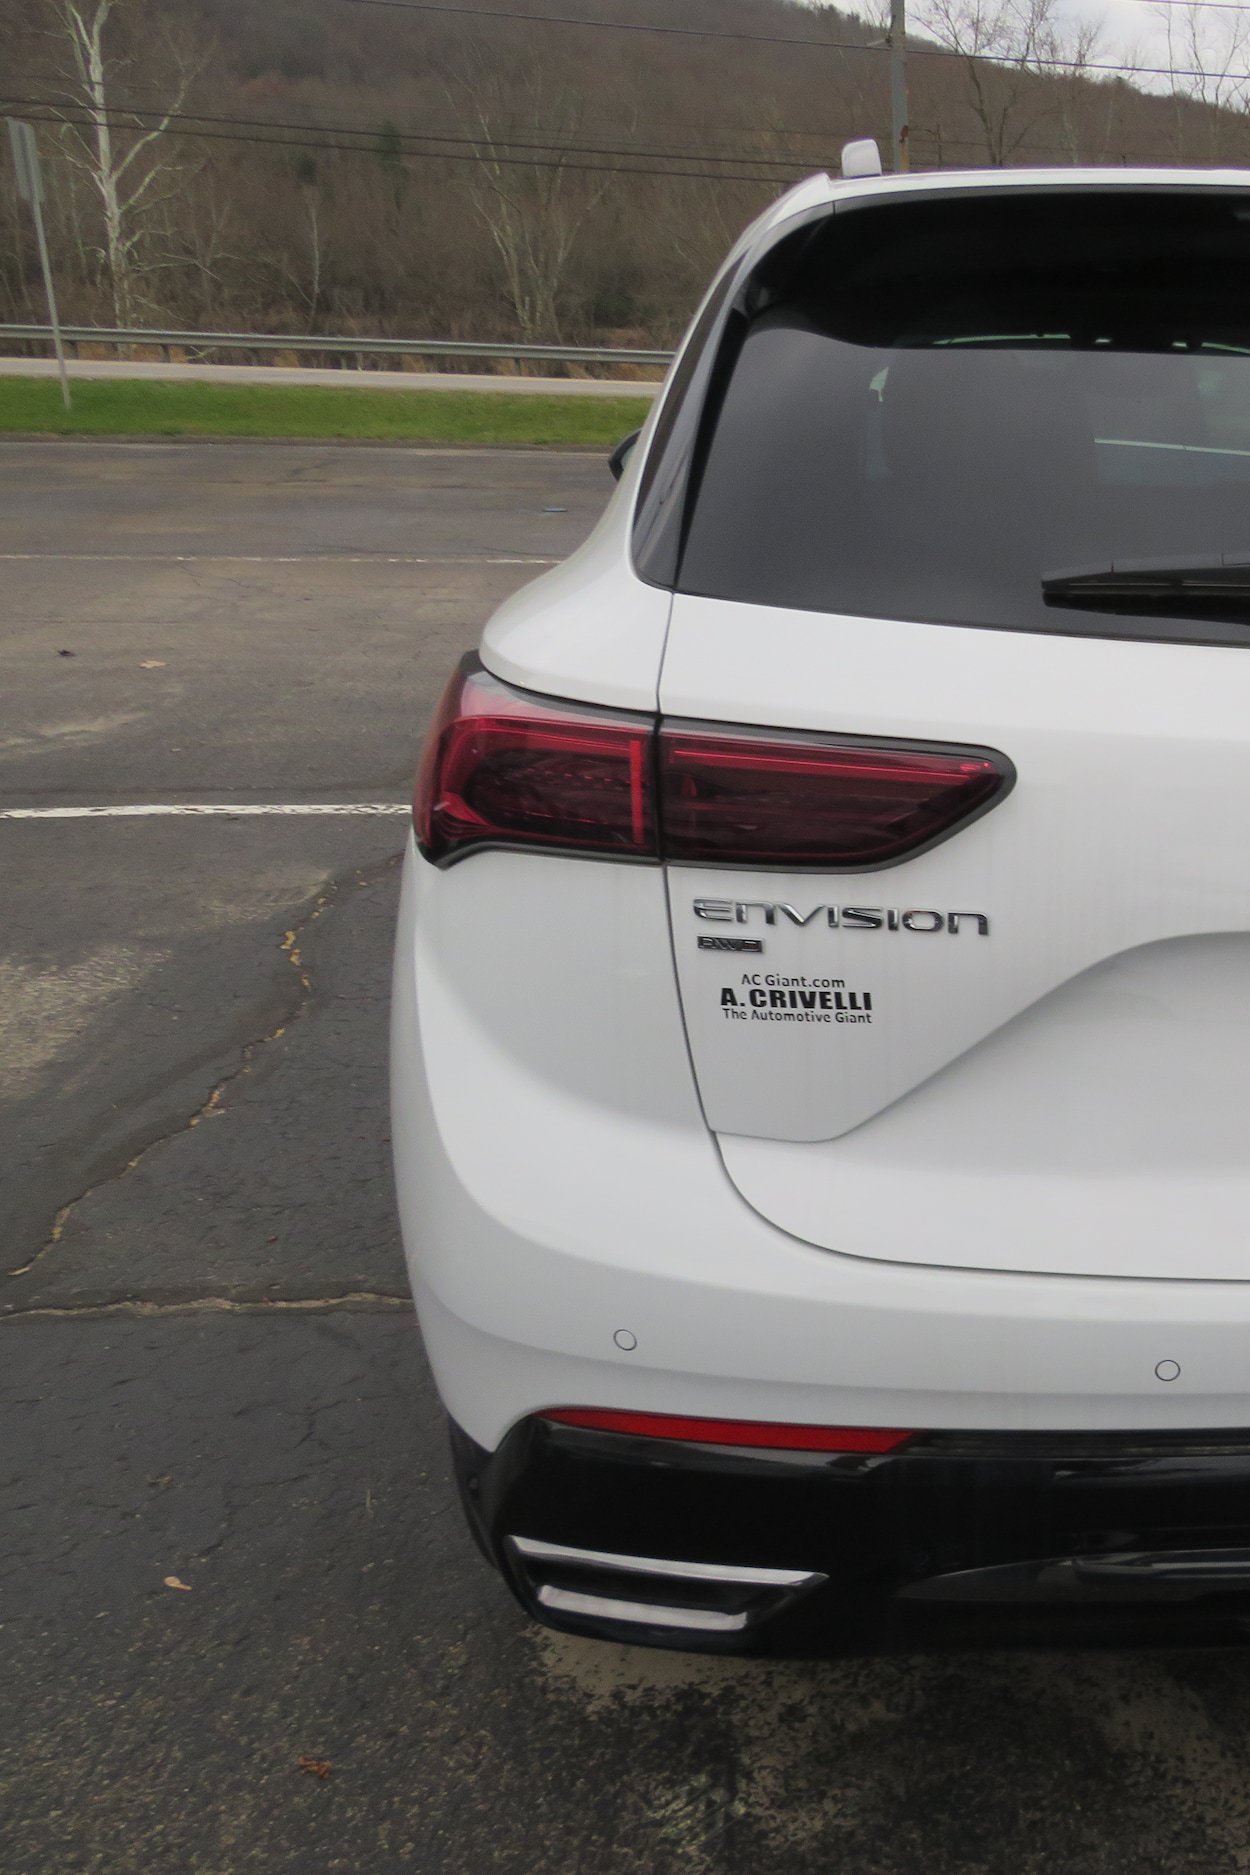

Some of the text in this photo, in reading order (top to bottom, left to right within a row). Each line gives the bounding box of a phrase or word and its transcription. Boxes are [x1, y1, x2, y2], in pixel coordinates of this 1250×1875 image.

[741, 973, 845, 988] AC Giant.com
[722, 1008, 872, 1023] The Automotive Giant
